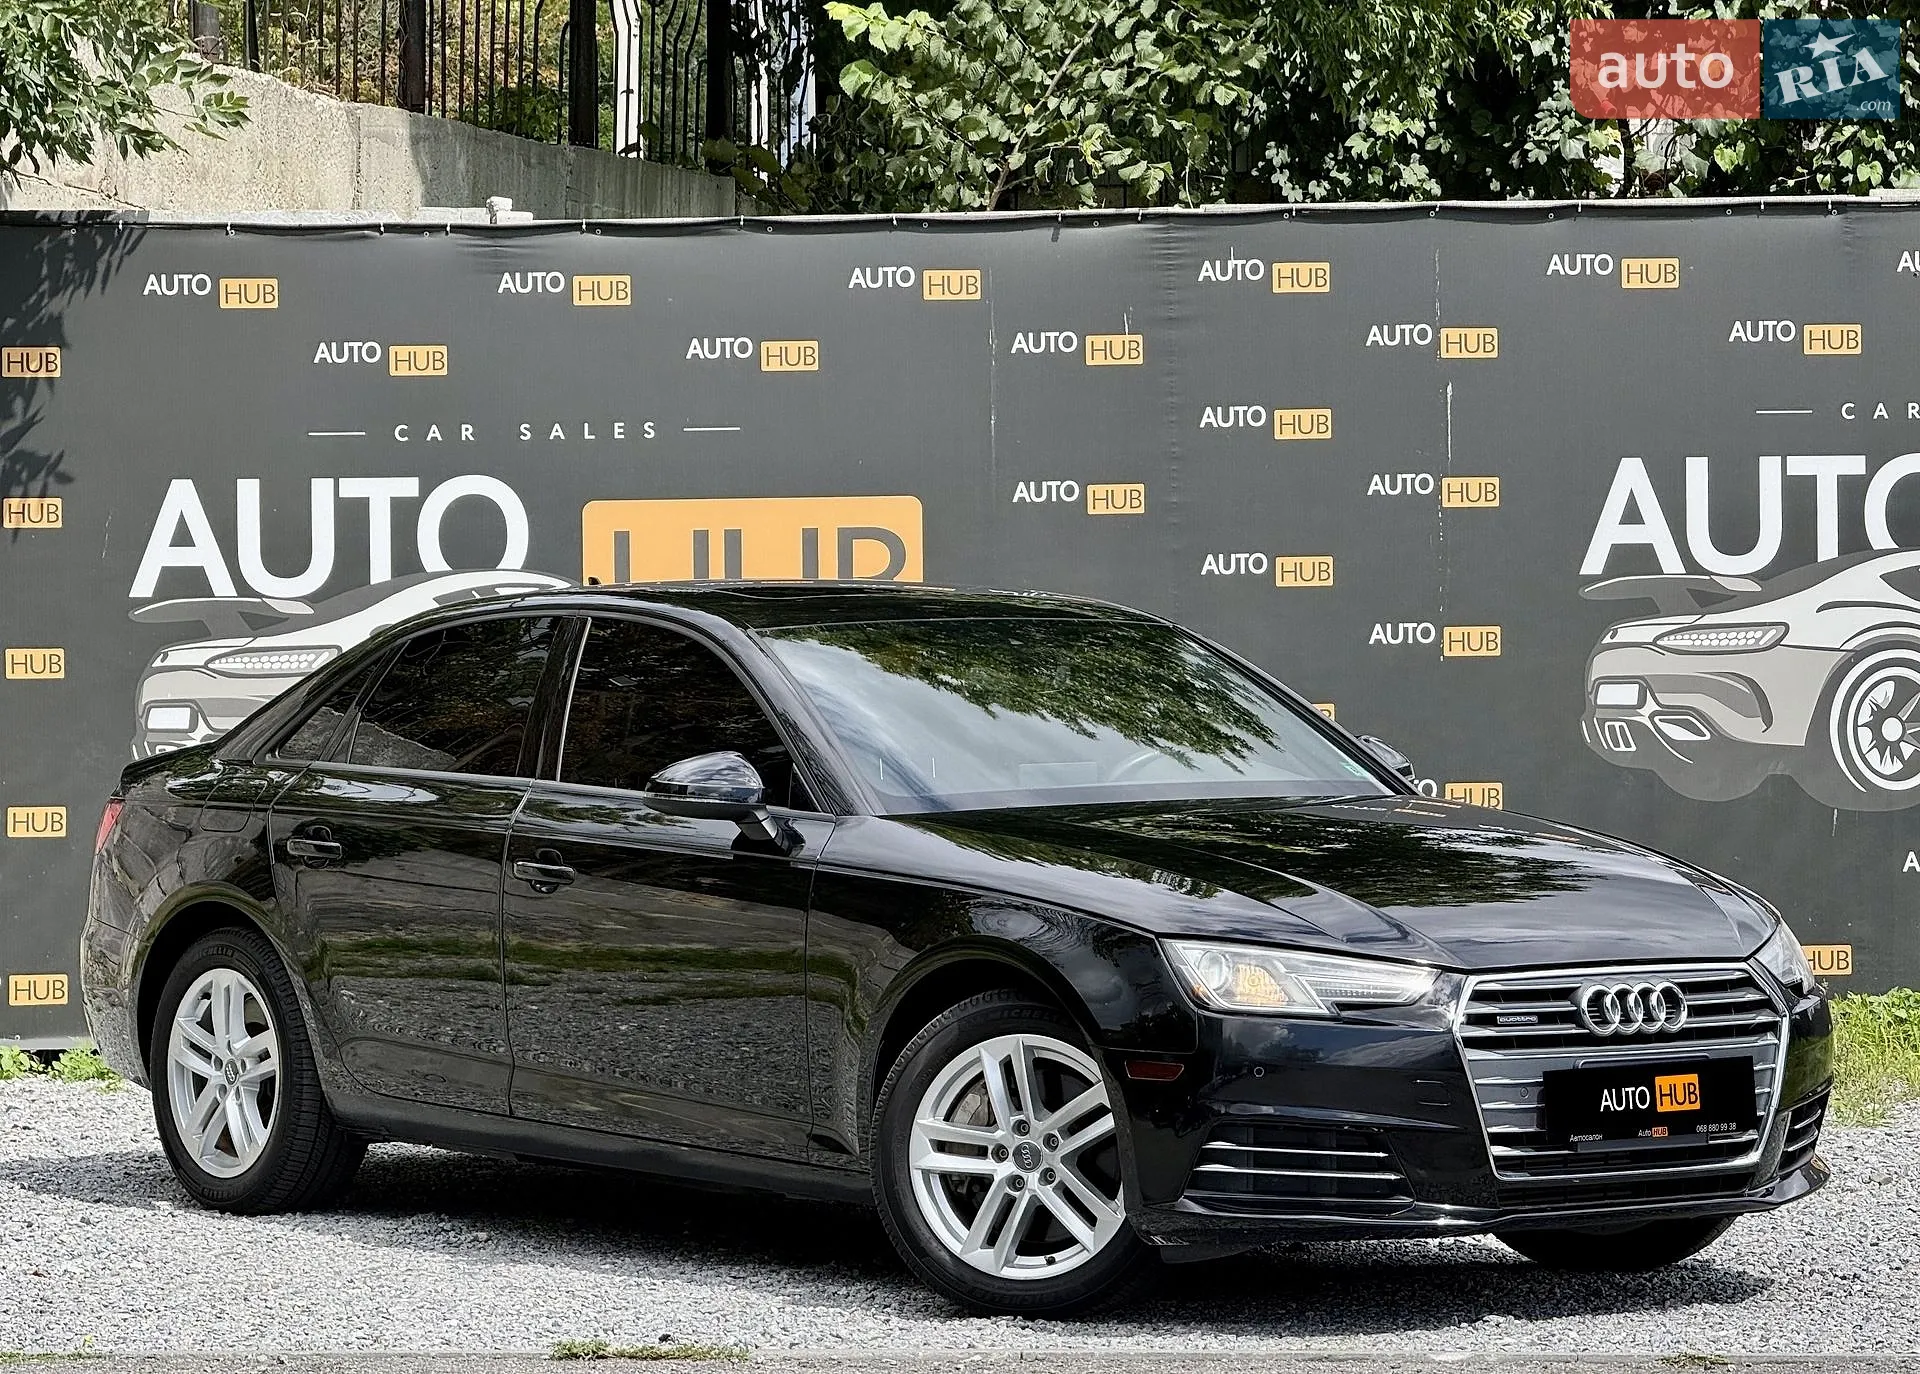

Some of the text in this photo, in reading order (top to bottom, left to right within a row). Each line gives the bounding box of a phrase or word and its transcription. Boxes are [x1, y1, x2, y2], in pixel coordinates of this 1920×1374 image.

[848, 266, 979, 295] AUTO HUB
[1198, 258, 1327, 288] AUTO HUB
[1547, 254, 1677, 284] AUTO HUB
[143, 274, 276, 304] AUTO HUB
[498, 272, 629, 301] AUTO HUB
[1011, 331, 1141, 360] AUTO HUB
[1366, 324, 1496, 353] AUTO HUB
[1729, 320, 1859, 350] AUTO HUB
[7, 352, 58, 372] HUB
[314, 342, 445, 371] AUTO HUB
[686, 337, 816, 366] AUTO HUB
[1200, 406, 1330, 435] AUTO HUB
[1841, 402, 1920, 420] CAR
[394, 422, 656, 442] CAR SALES
[1012, 481, 1142, 509] AUTO HUB
[1367, 473, 1497, 502] AUTO HUB
[8, 504, 59, 523] HUB
[129, 475, 529, 600] AUTO
[1201, 553, 1331, 582] AUTO HUB
[1369, 623, 1499, 652] AUTO HUB
[11, 655, 61, 674] HUB
[12, 813, 63, 832] HUB
[14, 981, 65, 1000] HUB
[1600, 1082, 1699, 1112] AUTO HUB
[1638, 1127, 1668, 1137] Auto HUB
[1696, 1124, 1707, 1132] 068
[1720, 1123, 1728, 1131] 99
[1729, 1122, 1737, 1130] 38
